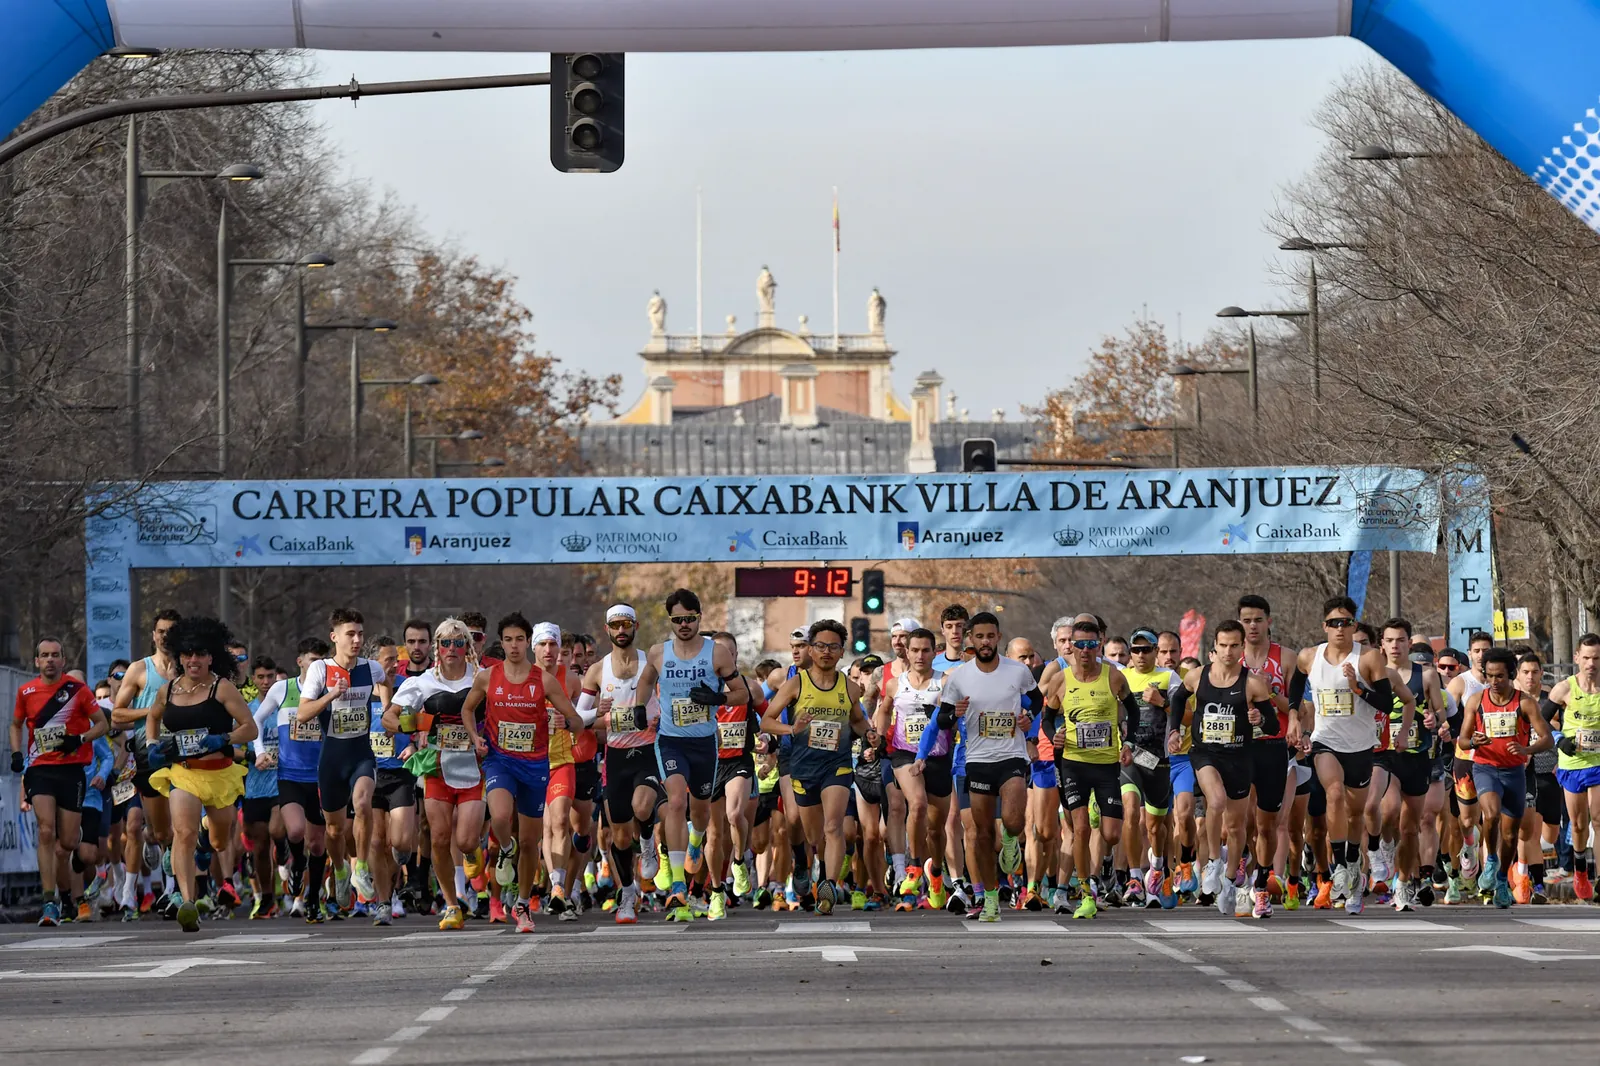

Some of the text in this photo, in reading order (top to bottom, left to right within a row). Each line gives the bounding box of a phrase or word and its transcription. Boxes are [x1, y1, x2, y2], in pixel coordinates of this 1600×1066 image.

[232, 476, 1342, 520] CARRERA POPULAR CAIXABANK VILLA DE ARANJUEZ
[1088, 525, 1170, 537] PATRIMONIO
[1255, 522, 1341, 539] CaixaBank
[596, 532, 678, 543] PATRIMONIO
[762, 530, 848, 546] CaixaBank
[922, 529, 1004, 546] Aranjuez
[1088, 537, 1154, 549] NACIONAL
[269, 535, 355, 552] CaixaBank
[428, 535, 511, 552] Aranjuez
[596, 544, 662, 554] NACIONAL
[795, 569, 848, 595] 9:12
[1512, 621, 1525, 632] 35
[665, 665, 706, 681] nerja
[681, 704, 705, 715] 3259
[342, 713, 365, 723] 3408
[989, 718, 1013, 727] 1728
[1206, 722, 1230, 731] 2881
[508, 730, 532, 740] 2490
[723, 728, 745, 738] 2440
[816, 728, 834, 738] 572
[1085, 728, 1108, 738] 4197
